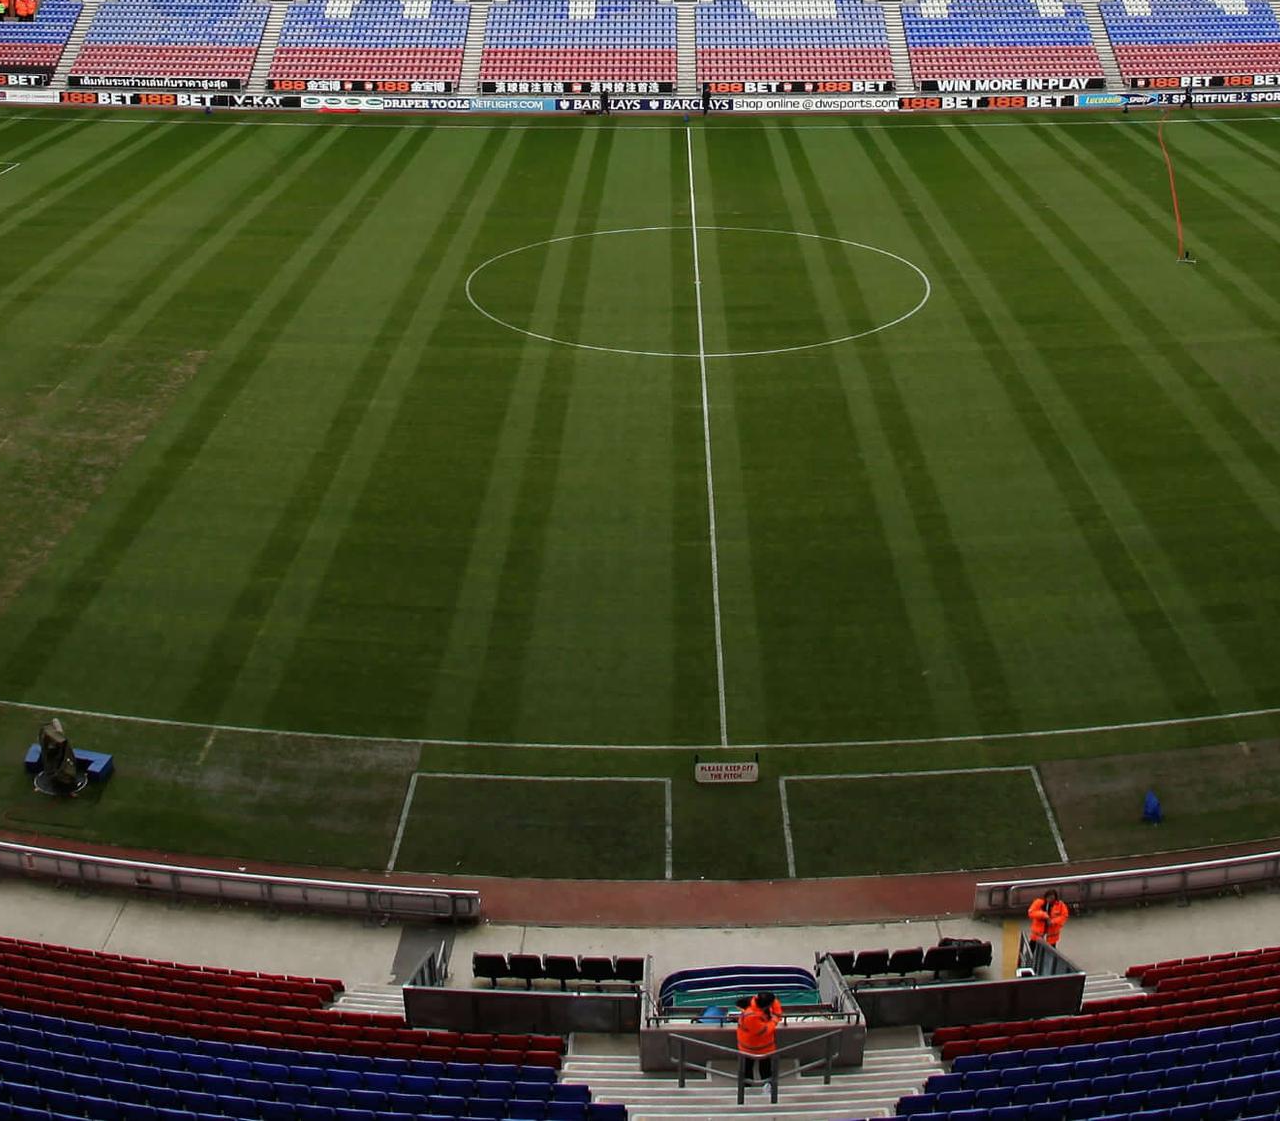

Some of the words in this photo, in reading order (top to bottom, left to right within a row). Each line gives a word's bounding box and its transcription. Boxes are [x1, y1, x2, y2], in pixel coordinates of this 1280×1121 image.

[709, 83, 779, 93] 188BET
[817, 83, 887, 93] 188BET
[938, 80, 977, 91] WIN
[982, 80, 1022, 91] MORE
[1026, 78, 1089, 90] IN-PLAY
[1149, 76, 1212, 88] 188BET
[62, 93, 134, 106] 188BET
[138, 93, 214, 106] 188BET
[233, 95, 283, 105] V-KAT
[384, 98, 429, 109] DRAPER
[431, 98, 469, 109] TOOLS
[573, 99, 640, 110] BARLAYS
[735, 99, 761, 112] shop
[766, 99, 800, 109] online
[815, 99, 899, 112] dwsports.com
[901, 97, 981, 110] 188BET
[987, 96, 1064, 109] 188BET
